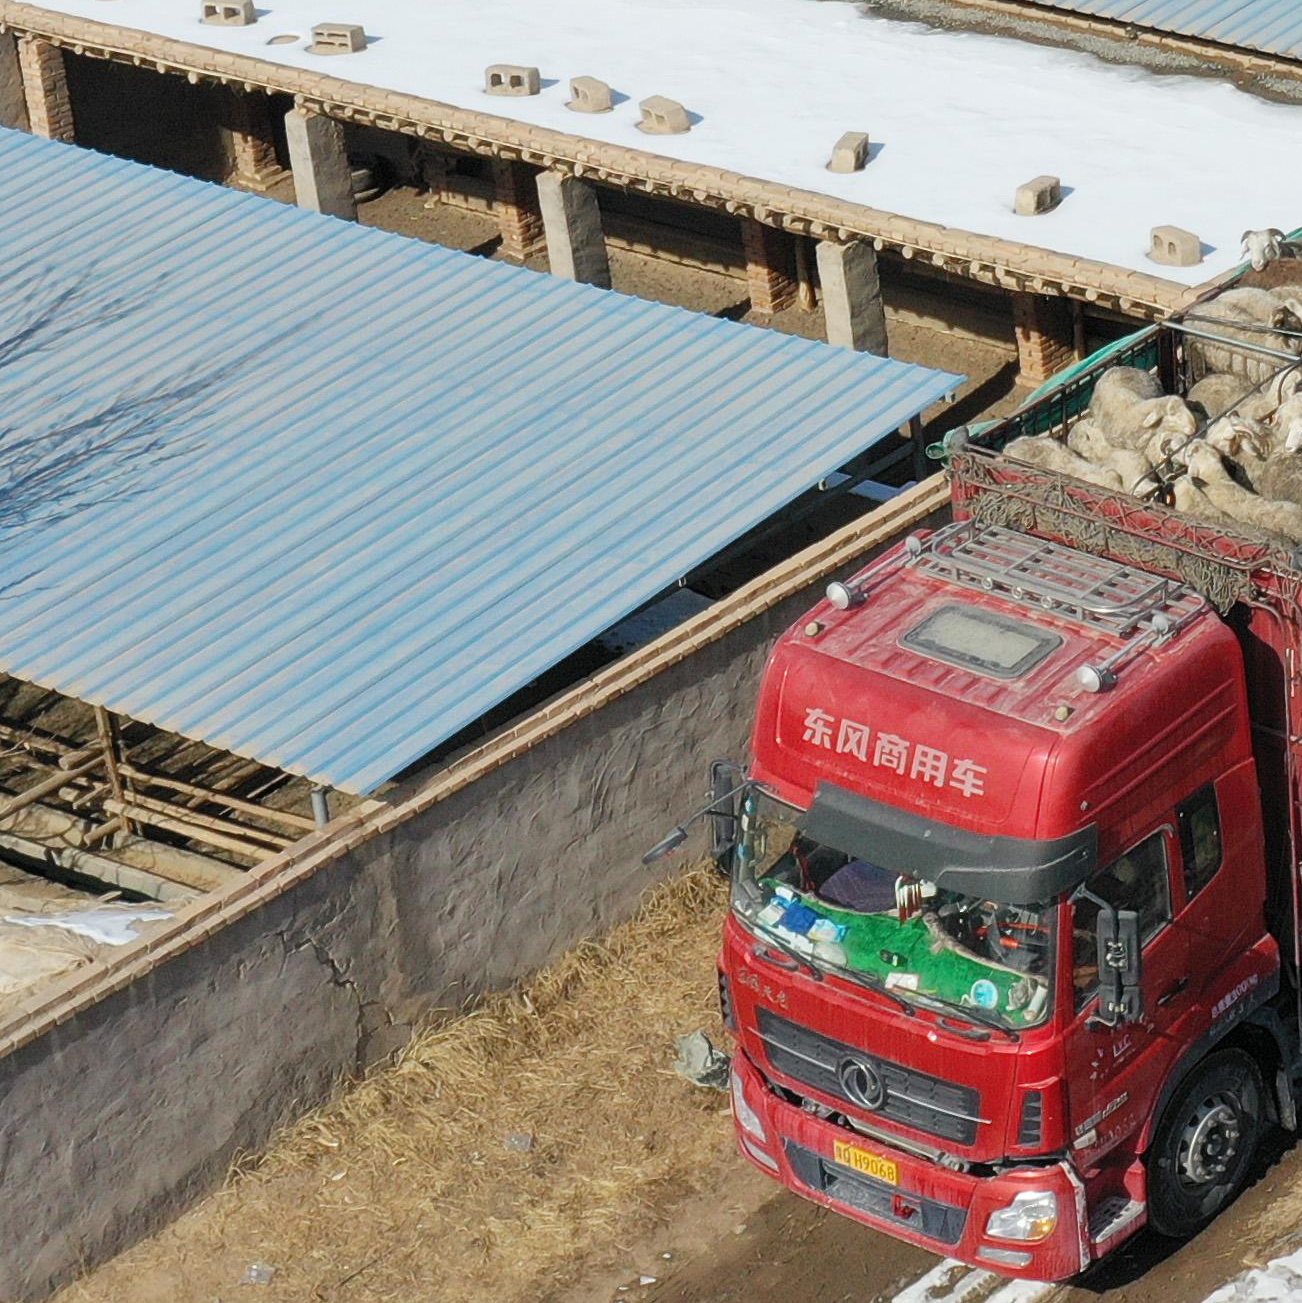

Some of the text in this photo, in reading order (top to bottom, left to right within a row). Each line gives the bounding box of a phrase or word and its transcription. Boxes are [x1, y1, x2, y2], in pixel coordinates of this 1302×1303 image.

[802, 707, 988, 798] 东风商用车
